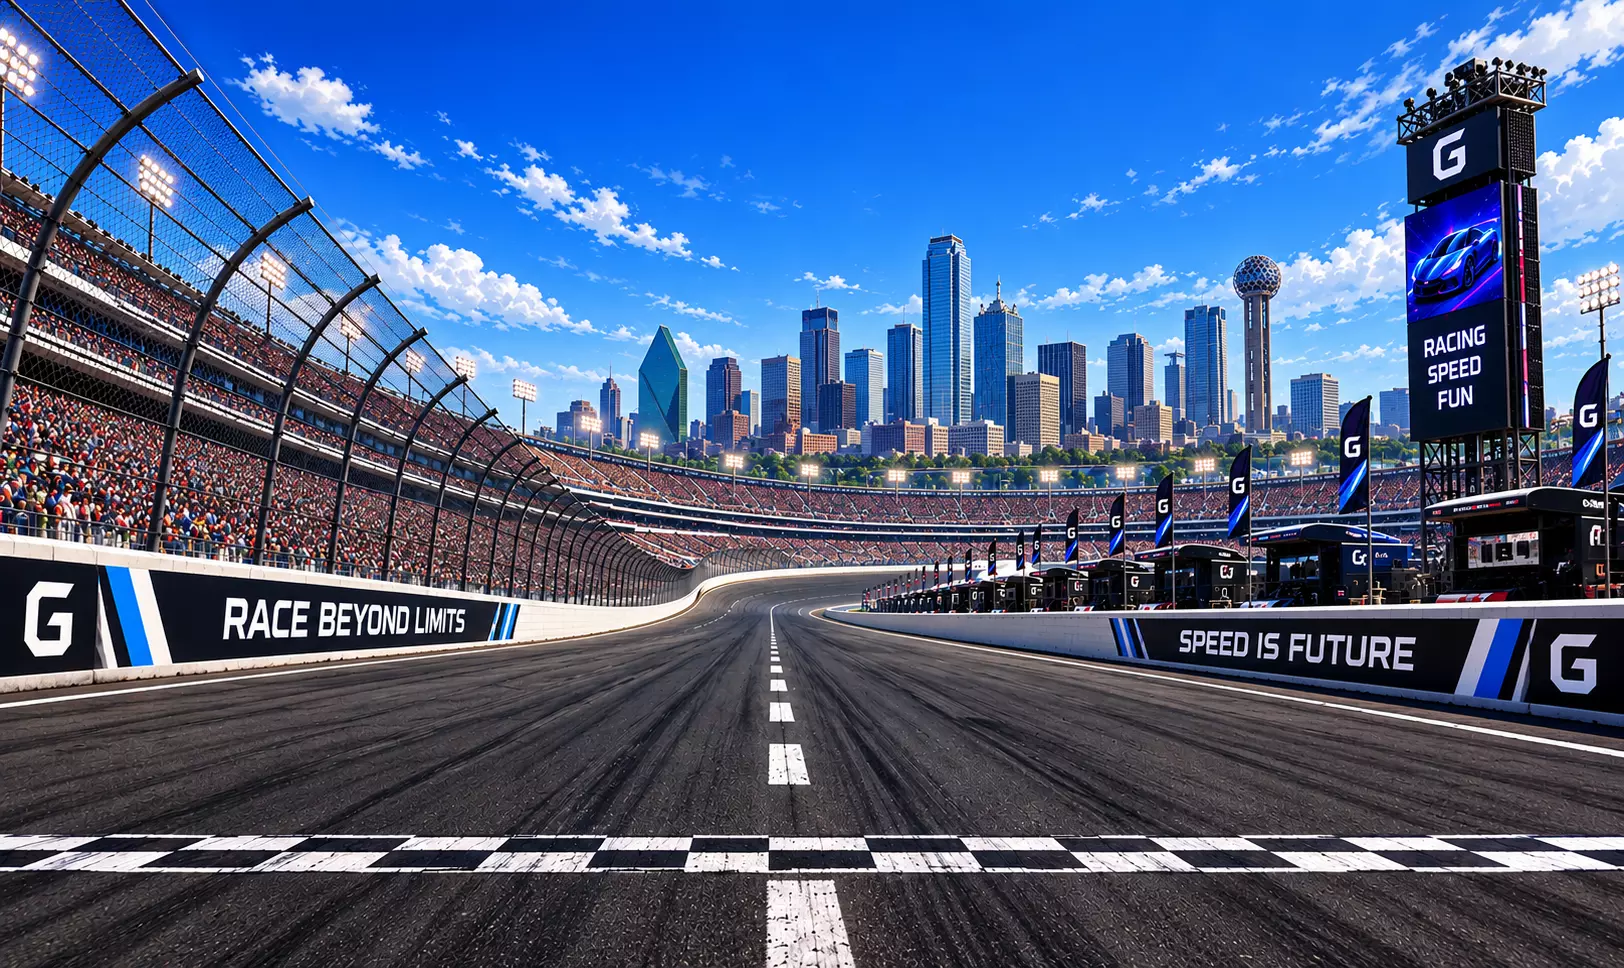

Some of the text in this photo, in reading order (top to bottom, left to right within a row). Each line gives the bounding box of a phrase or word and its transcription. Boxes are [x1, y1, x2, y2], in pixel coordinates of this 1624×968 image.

[1433, 128, 1466, 181] G
[1424, 325, 1486, 358] RACING
[1428, 355, 1482, 385] SPEED
[1438, 385, 1473, 410] FUN
[1579, 403, 1598, 428] G
[1344, 435, 1361, 458] G
[1232, 477, 1246, 494] G
[1158, 498, 1169, 514] G
[1067, 526, 1076, 539] G
[1111, 515, 1121, 528] G
[24, 581, 75, 657] G
[222, 597, 466, 640] RACE BEYOND LIMITS
[1179, 629, 1417, 671] SPEED IS FUTURE
[1550, 633, 1597, 695] G
